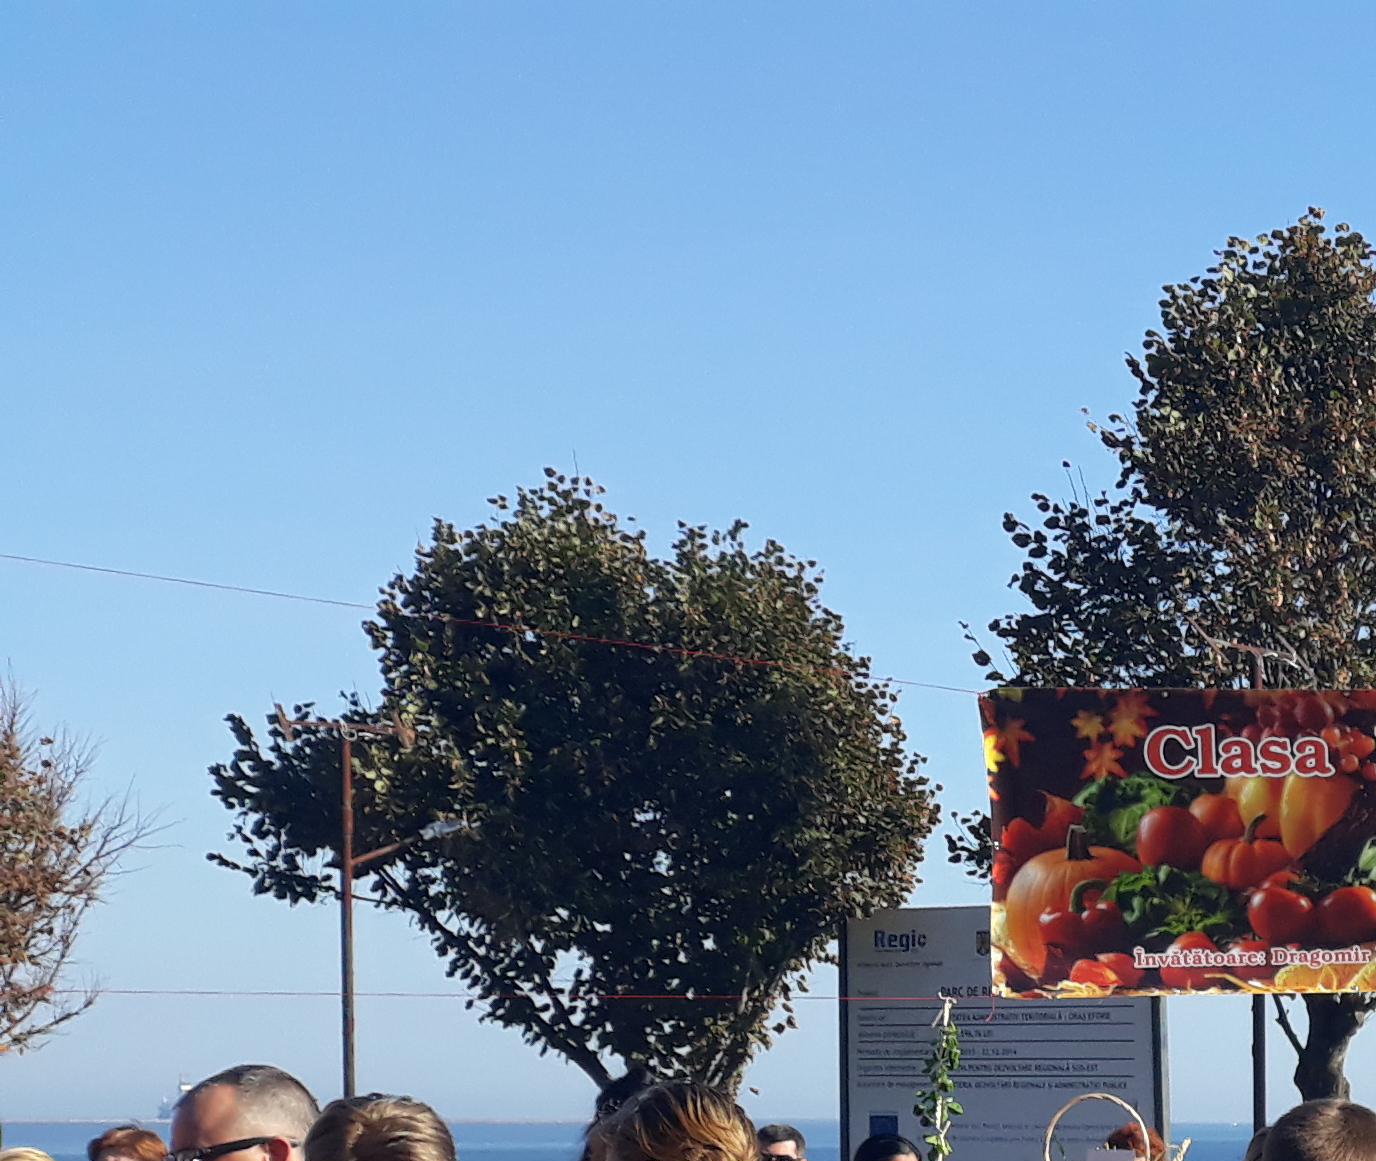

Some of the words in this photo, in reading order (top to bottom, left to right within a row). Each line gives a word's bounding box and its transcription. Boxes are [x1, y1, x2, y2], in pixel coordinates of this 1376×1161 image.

[1144, 723, 1334, 779] Clasa
[1271, 945, 1371, 969] Dragomir
[967, 986, 979, 997] DE
